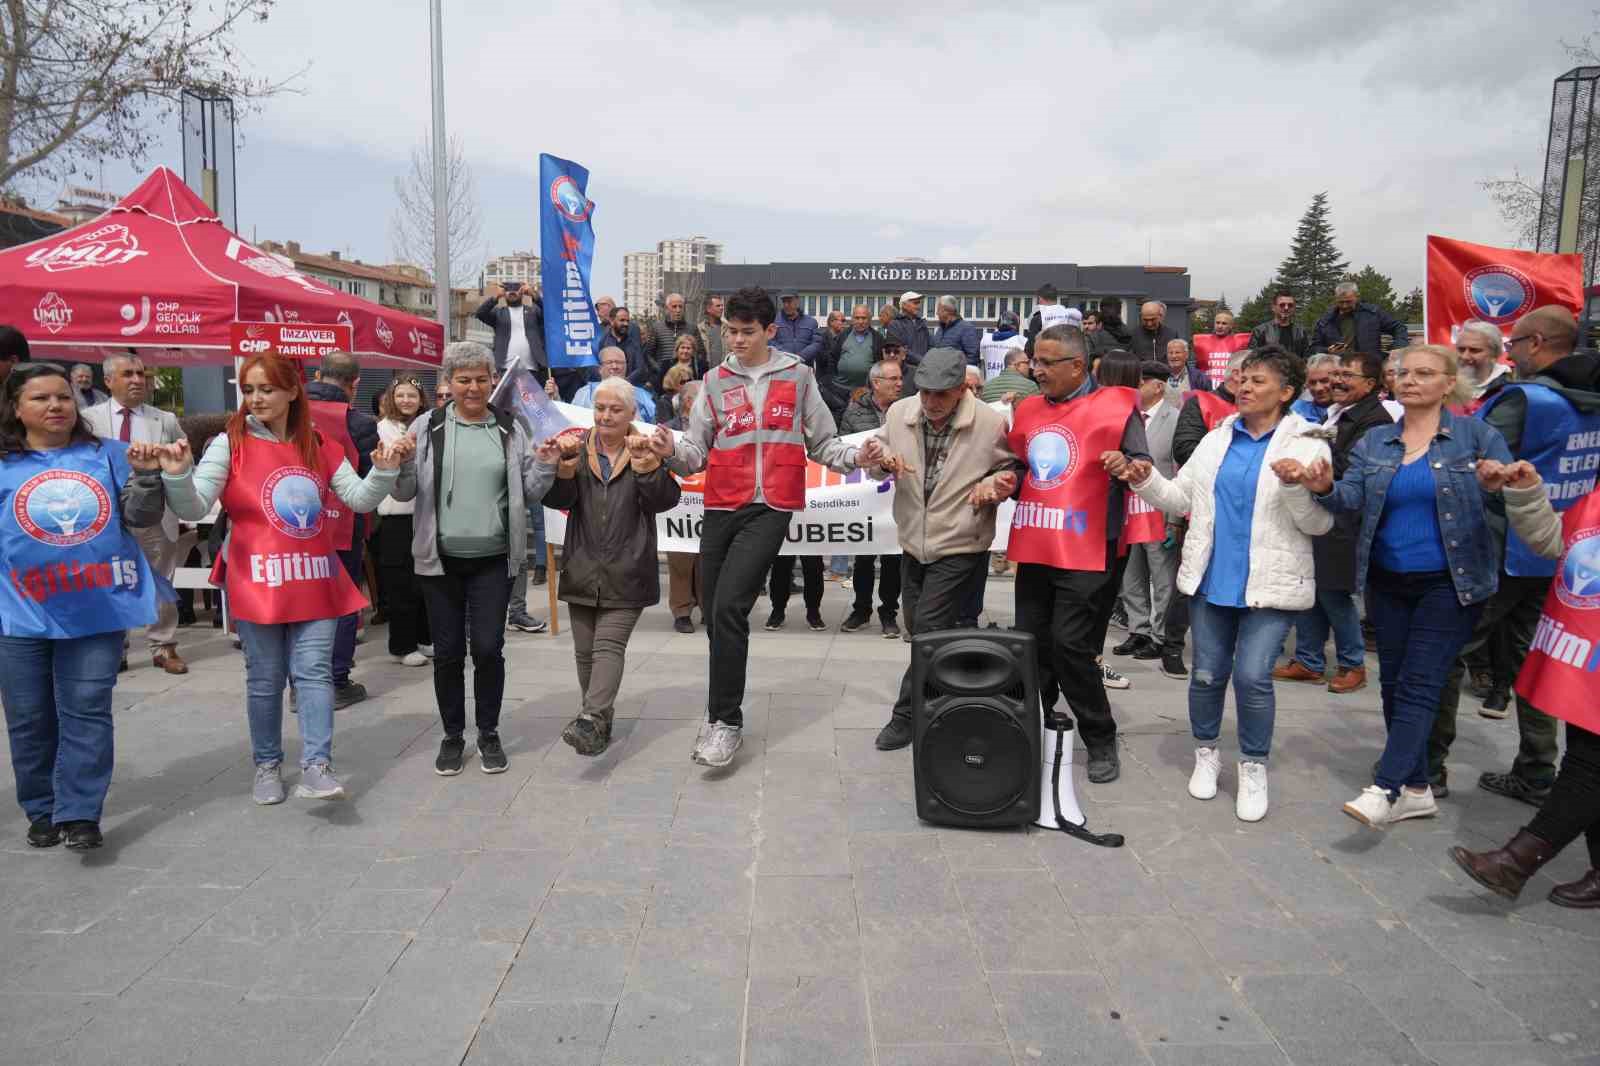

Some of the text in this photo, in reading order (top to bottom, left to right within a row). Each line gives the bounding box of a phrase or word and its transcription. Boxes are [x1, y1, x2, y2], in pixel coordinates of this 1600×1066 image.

[829, 266, 1017, 281] T.C. NİĞDE BELEDİYESİ
[156, 302, 180, 311] CHP
[33, 308, 74, 322] UMUT
[156, 311, 201, 323] GENÇLİK
[155, 324, 200, 335] KOLLARI
[281, 327, 336, 343] İMZA VER
[240, 339, 271, 353] CHP
[276, 343, 317, 355] TARİHE
[809, 498, 861, 510] Sendikası
[785, 516, 874, 544] UBESİ
